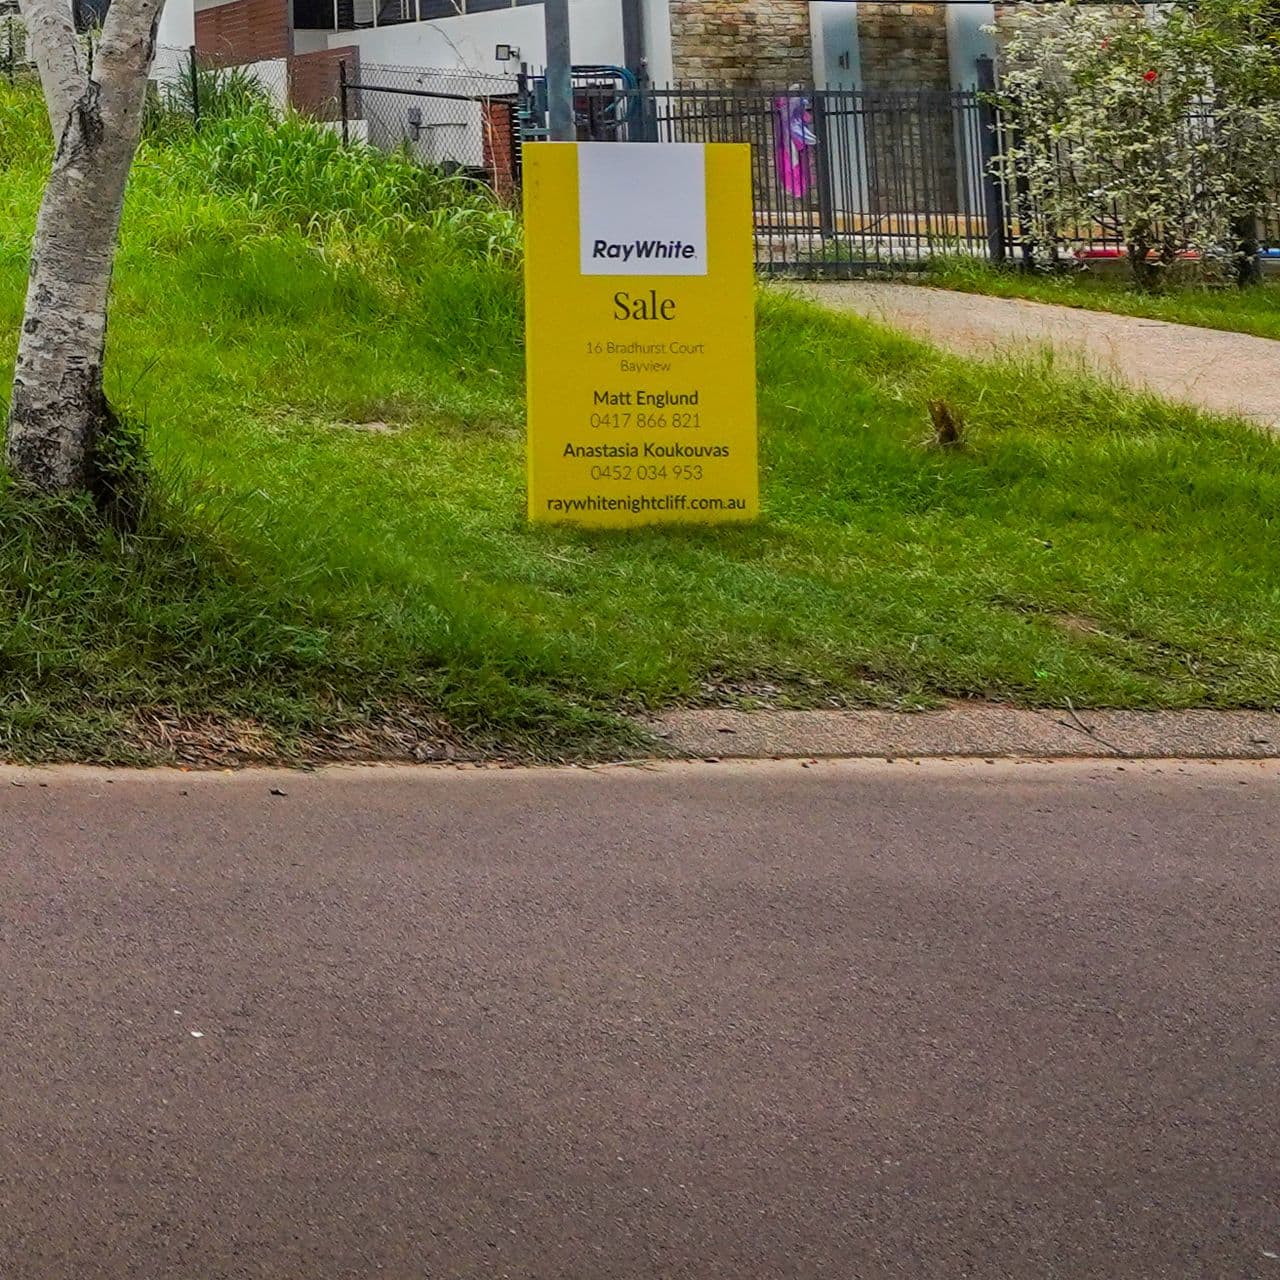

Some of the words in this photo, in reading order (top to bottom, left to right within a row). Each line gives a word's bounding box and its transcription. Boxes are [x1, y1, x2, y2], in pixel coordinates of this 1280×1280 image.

[614, 290, 676, 321] Sale
[587, 342, 603, 354] 16
[607, 341, 666, 354] Bradhurst
[669, 342, 705, 354] Court
[620, 360, 671, 373] Bayview
[593, 391, 632, 405] Matt
[637, 390, 699, 408] Englund
[591, 413, 631, 428] 0417
[637, 413, 667, 428] 866
[672, 413, 701, 428] 821
[563, 443, 639, 458] Anastasia
[644, 443, 729, 458] Koukouvas
[591, 465, 632, 480] 0452
[637, 465, 667, 480] 034
[672, 465, 703, 480] 953
[547, 495, 746, 513] raywhitenightcliff.com.au
